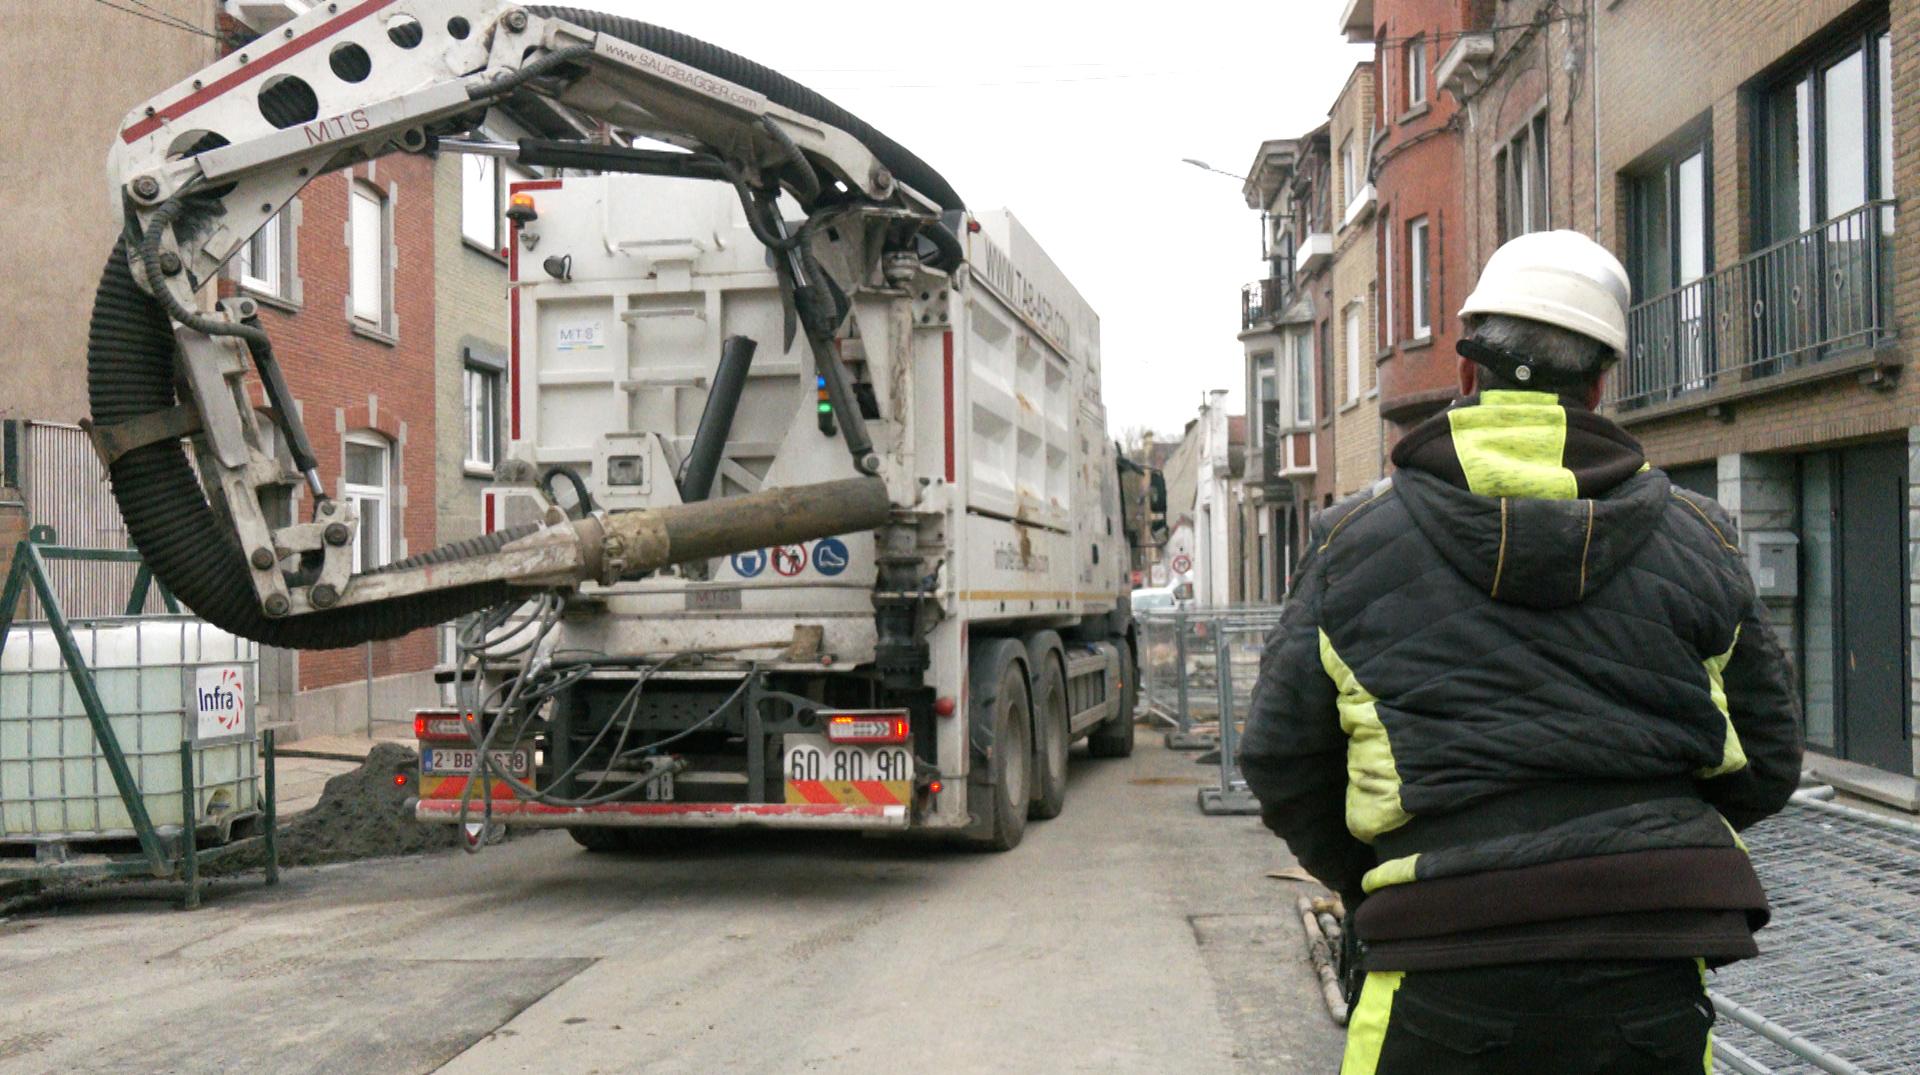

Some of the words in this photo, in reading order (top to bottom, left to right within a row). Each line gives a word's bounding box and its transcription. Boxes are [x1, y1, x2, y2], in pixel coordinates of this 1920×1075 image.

[303, 108, 370, 145] MTS
[199, 685, 233, 711] Infra
[791, 749, 820, 780] 60
[834, 750, 863, 780] 80
[877, 751, 906, 780] 90
